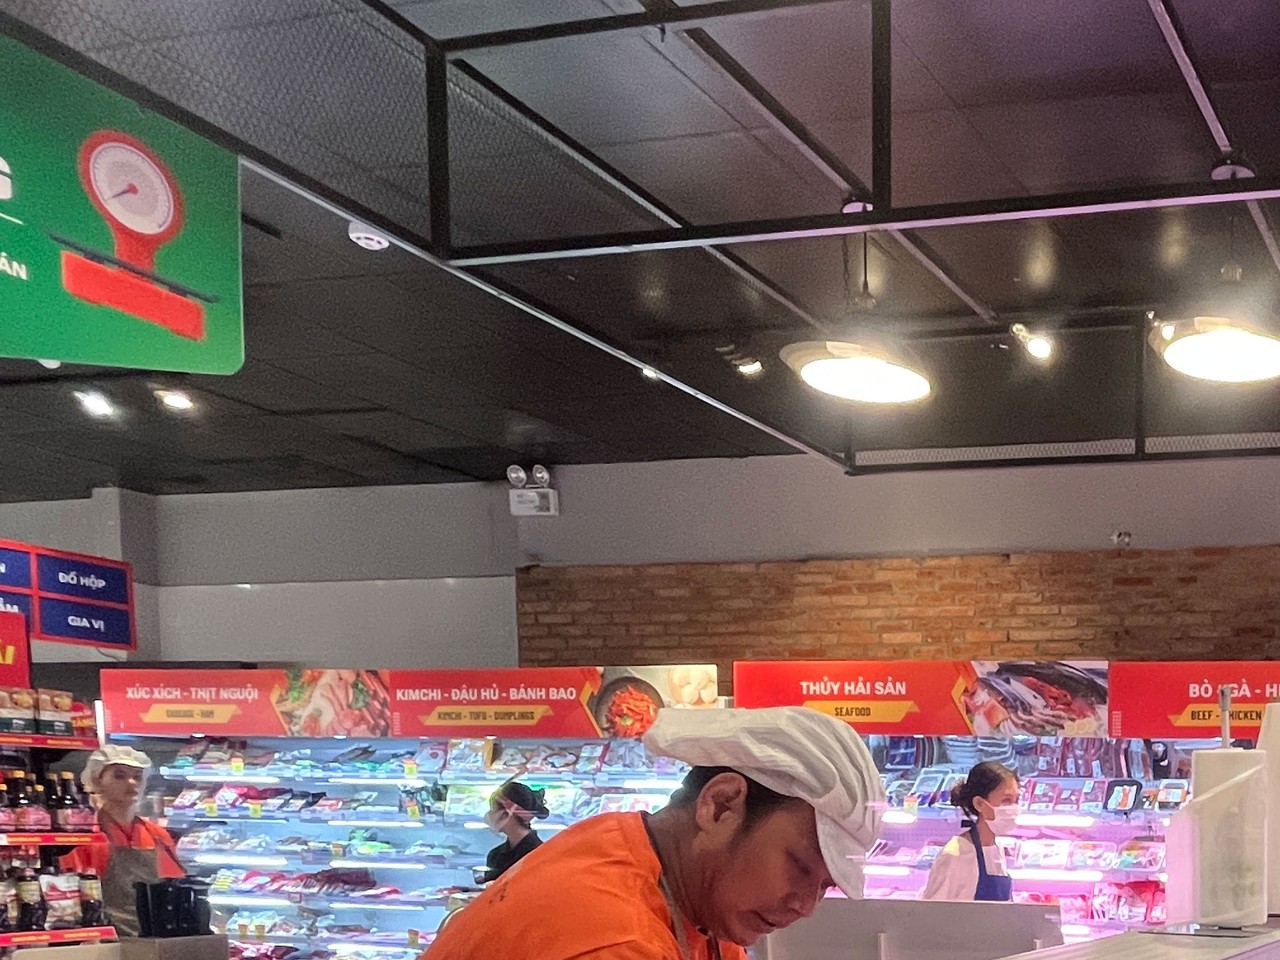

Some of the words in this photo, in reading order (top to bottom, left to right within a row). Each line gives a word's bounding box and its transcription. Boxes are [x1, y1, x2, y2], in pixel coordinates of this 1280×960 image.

[67, 615, 90, 628] GIA
[91, 619, 105, 632] VỊ
[126, 683, 151, 700] XÚC
[152, 683, 182, 700] XÍCH
[190, 687, 217, 702] THỊT
[219, 683, 259, 703] NGUỘI
[396, 688, 442, 701] KIMCHI
[451, 684, 477, 703] ĐẬU
[481, 683, 499, 700] HỦ
[510, 683, 546, 700] BÁNH
[549, 687, 577, 700] BAO
[800, 676, 841, 695] THỦY
[844, 676, 871, 695] HẢI
[874, 676, 906, 695] SẢN
[1188, 678, 1213, 698] BÒ
[1229, 678, 1251, 698] GÀ
[834, 707, 871, 717] SEAFOOD
[1190, 710, 1214, 721] BEEF
[1228, 710, 1262, 721] HICKEN
